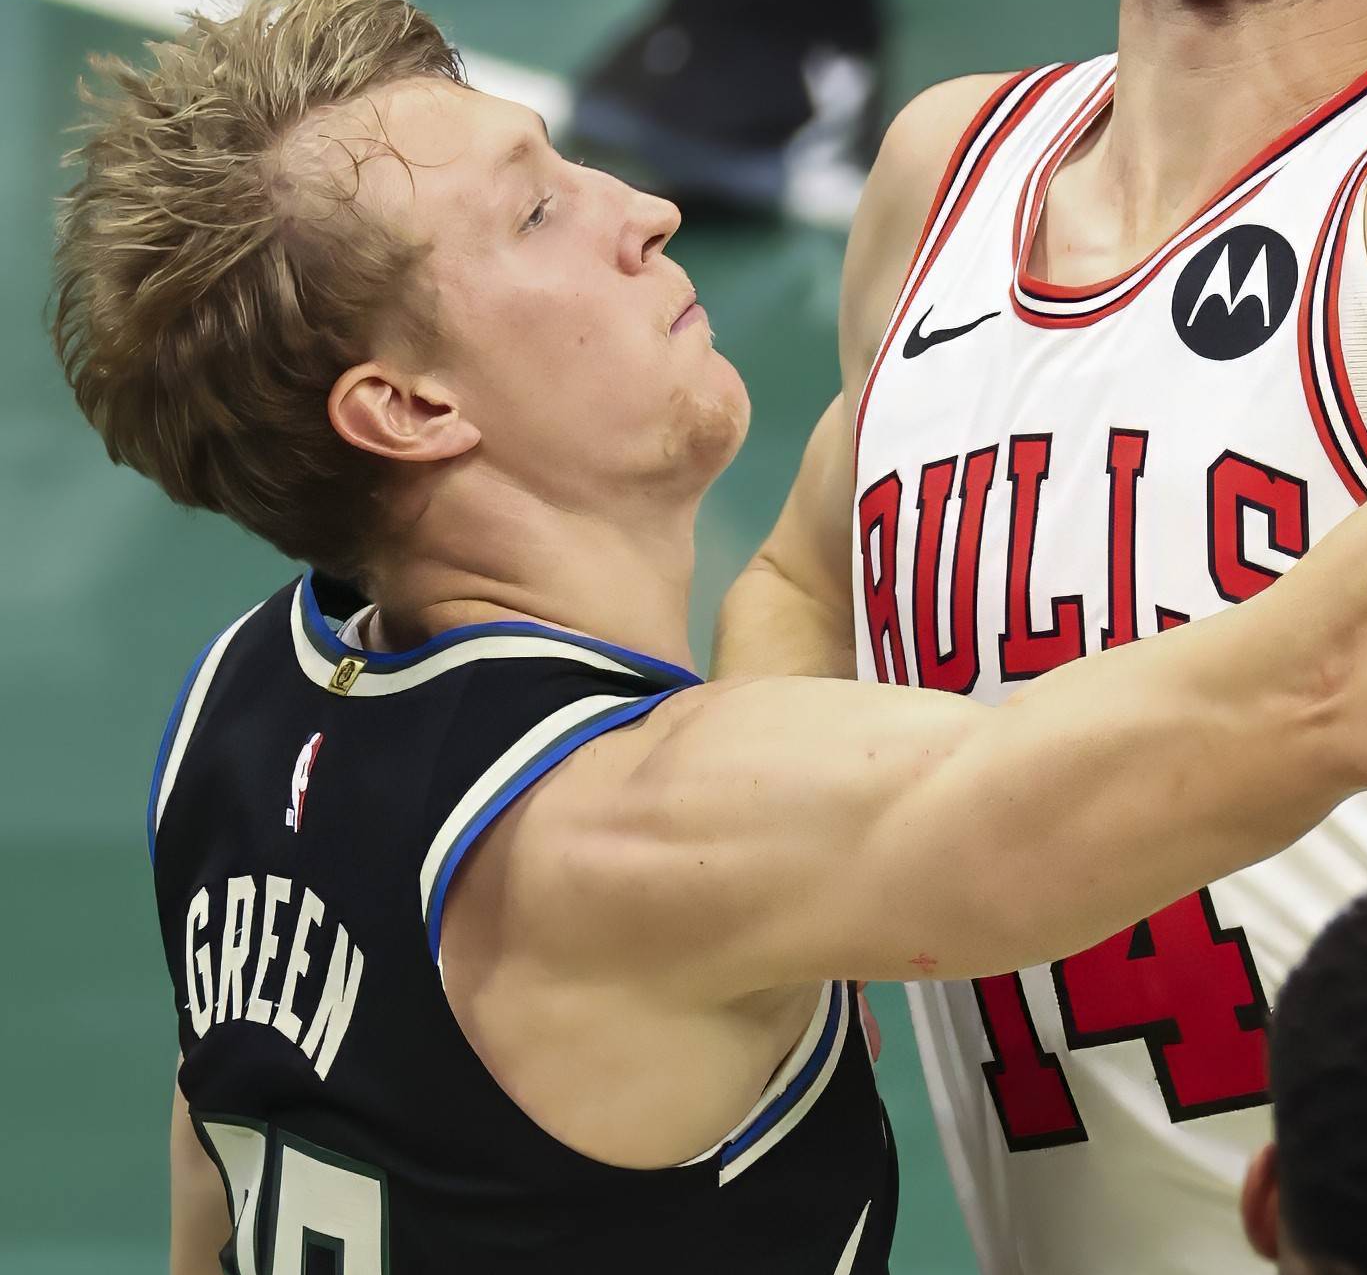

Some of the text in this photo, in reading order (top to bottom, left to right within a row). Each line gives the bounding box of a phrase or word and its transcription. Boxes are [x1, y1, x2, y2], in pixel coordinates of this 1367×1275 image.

[858, 426, 1309, 695] BULLS
[185, 873, 365, 1082] GREEN
[972, 885, 1275, 1152] 14
